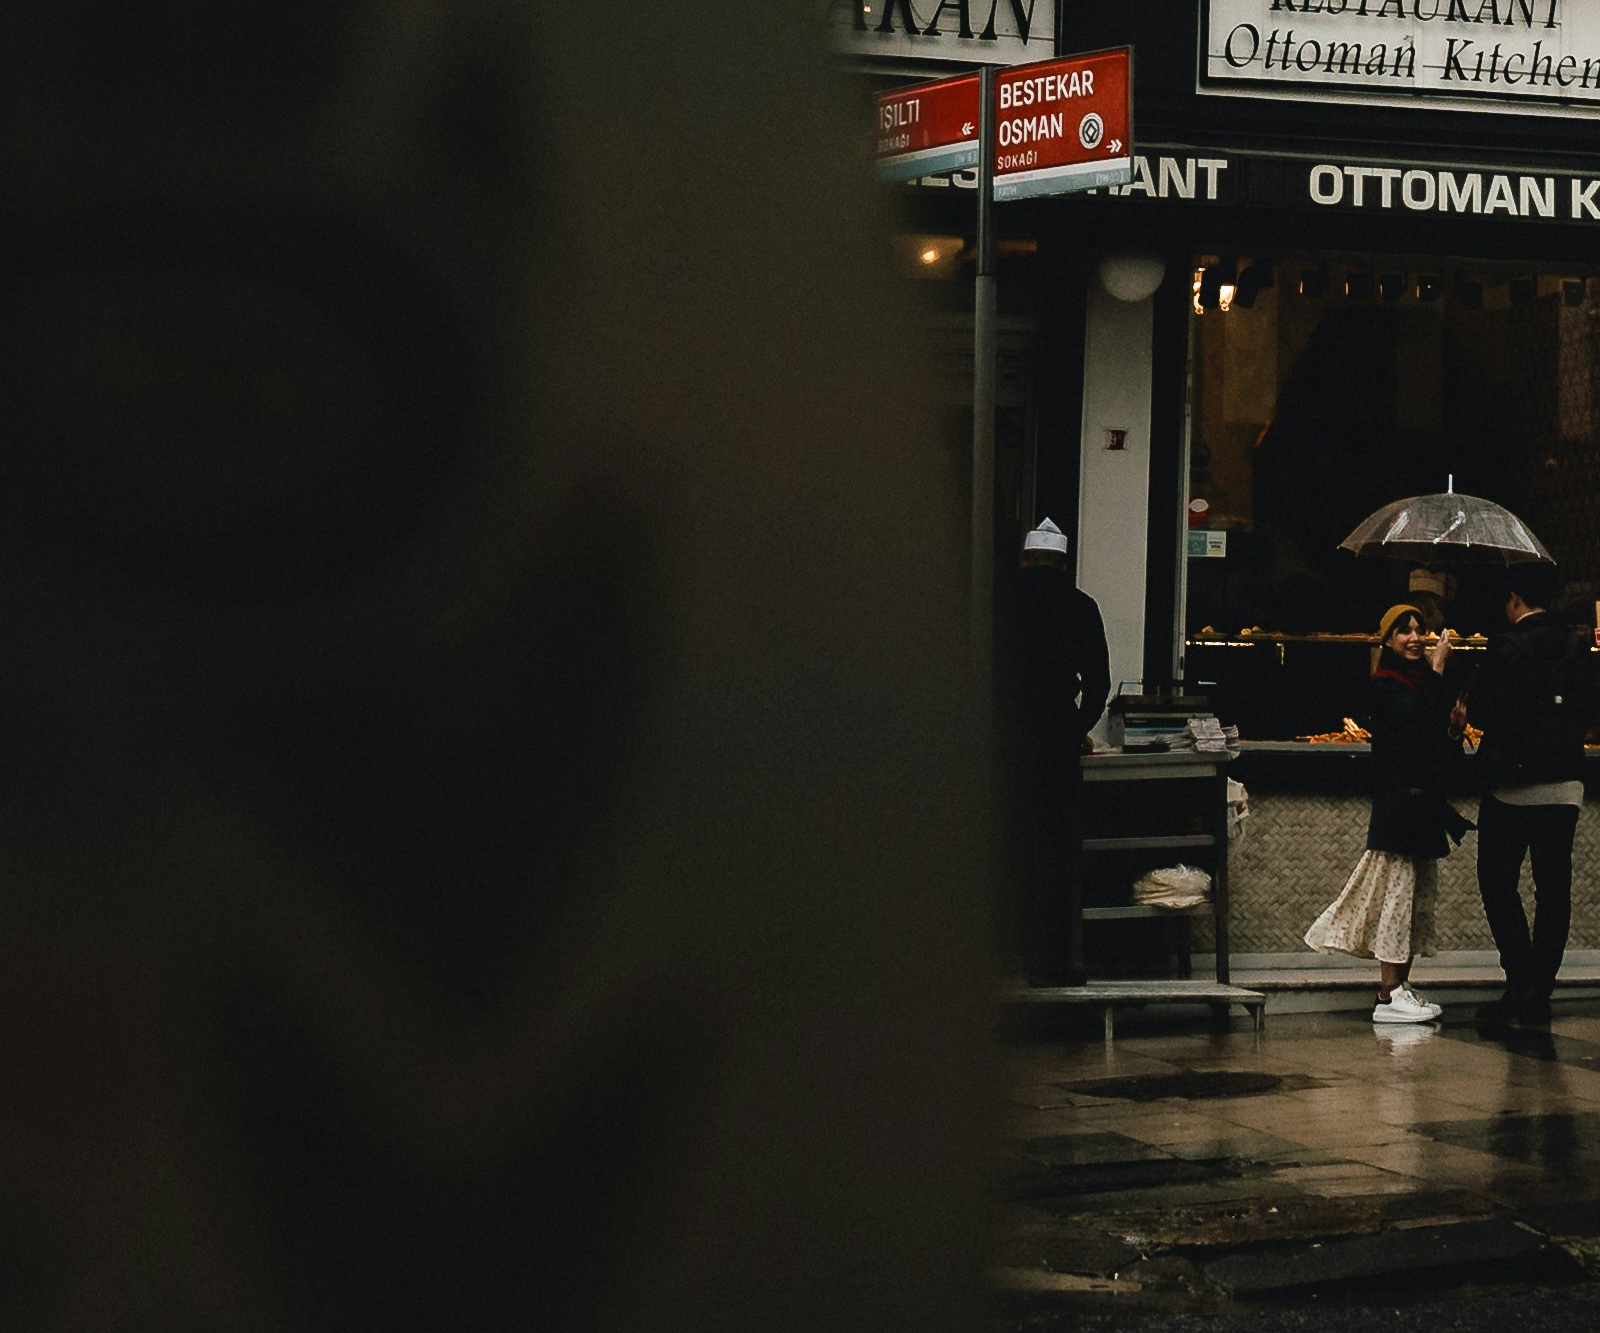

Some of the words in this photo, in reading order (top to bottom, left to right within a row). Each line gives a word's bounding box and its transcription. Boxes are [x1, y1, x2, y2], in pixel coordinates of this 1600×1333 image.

[1224, 23, 1416, 79] Ottoman
[1000, 70, 1094, 109] BESTEKAR
[999, 113, 1063, 146] OSMAN
[997, 151, 1038, 170] SOKAĞI
[1309, 164, 1555, 218] OTTOMAN
